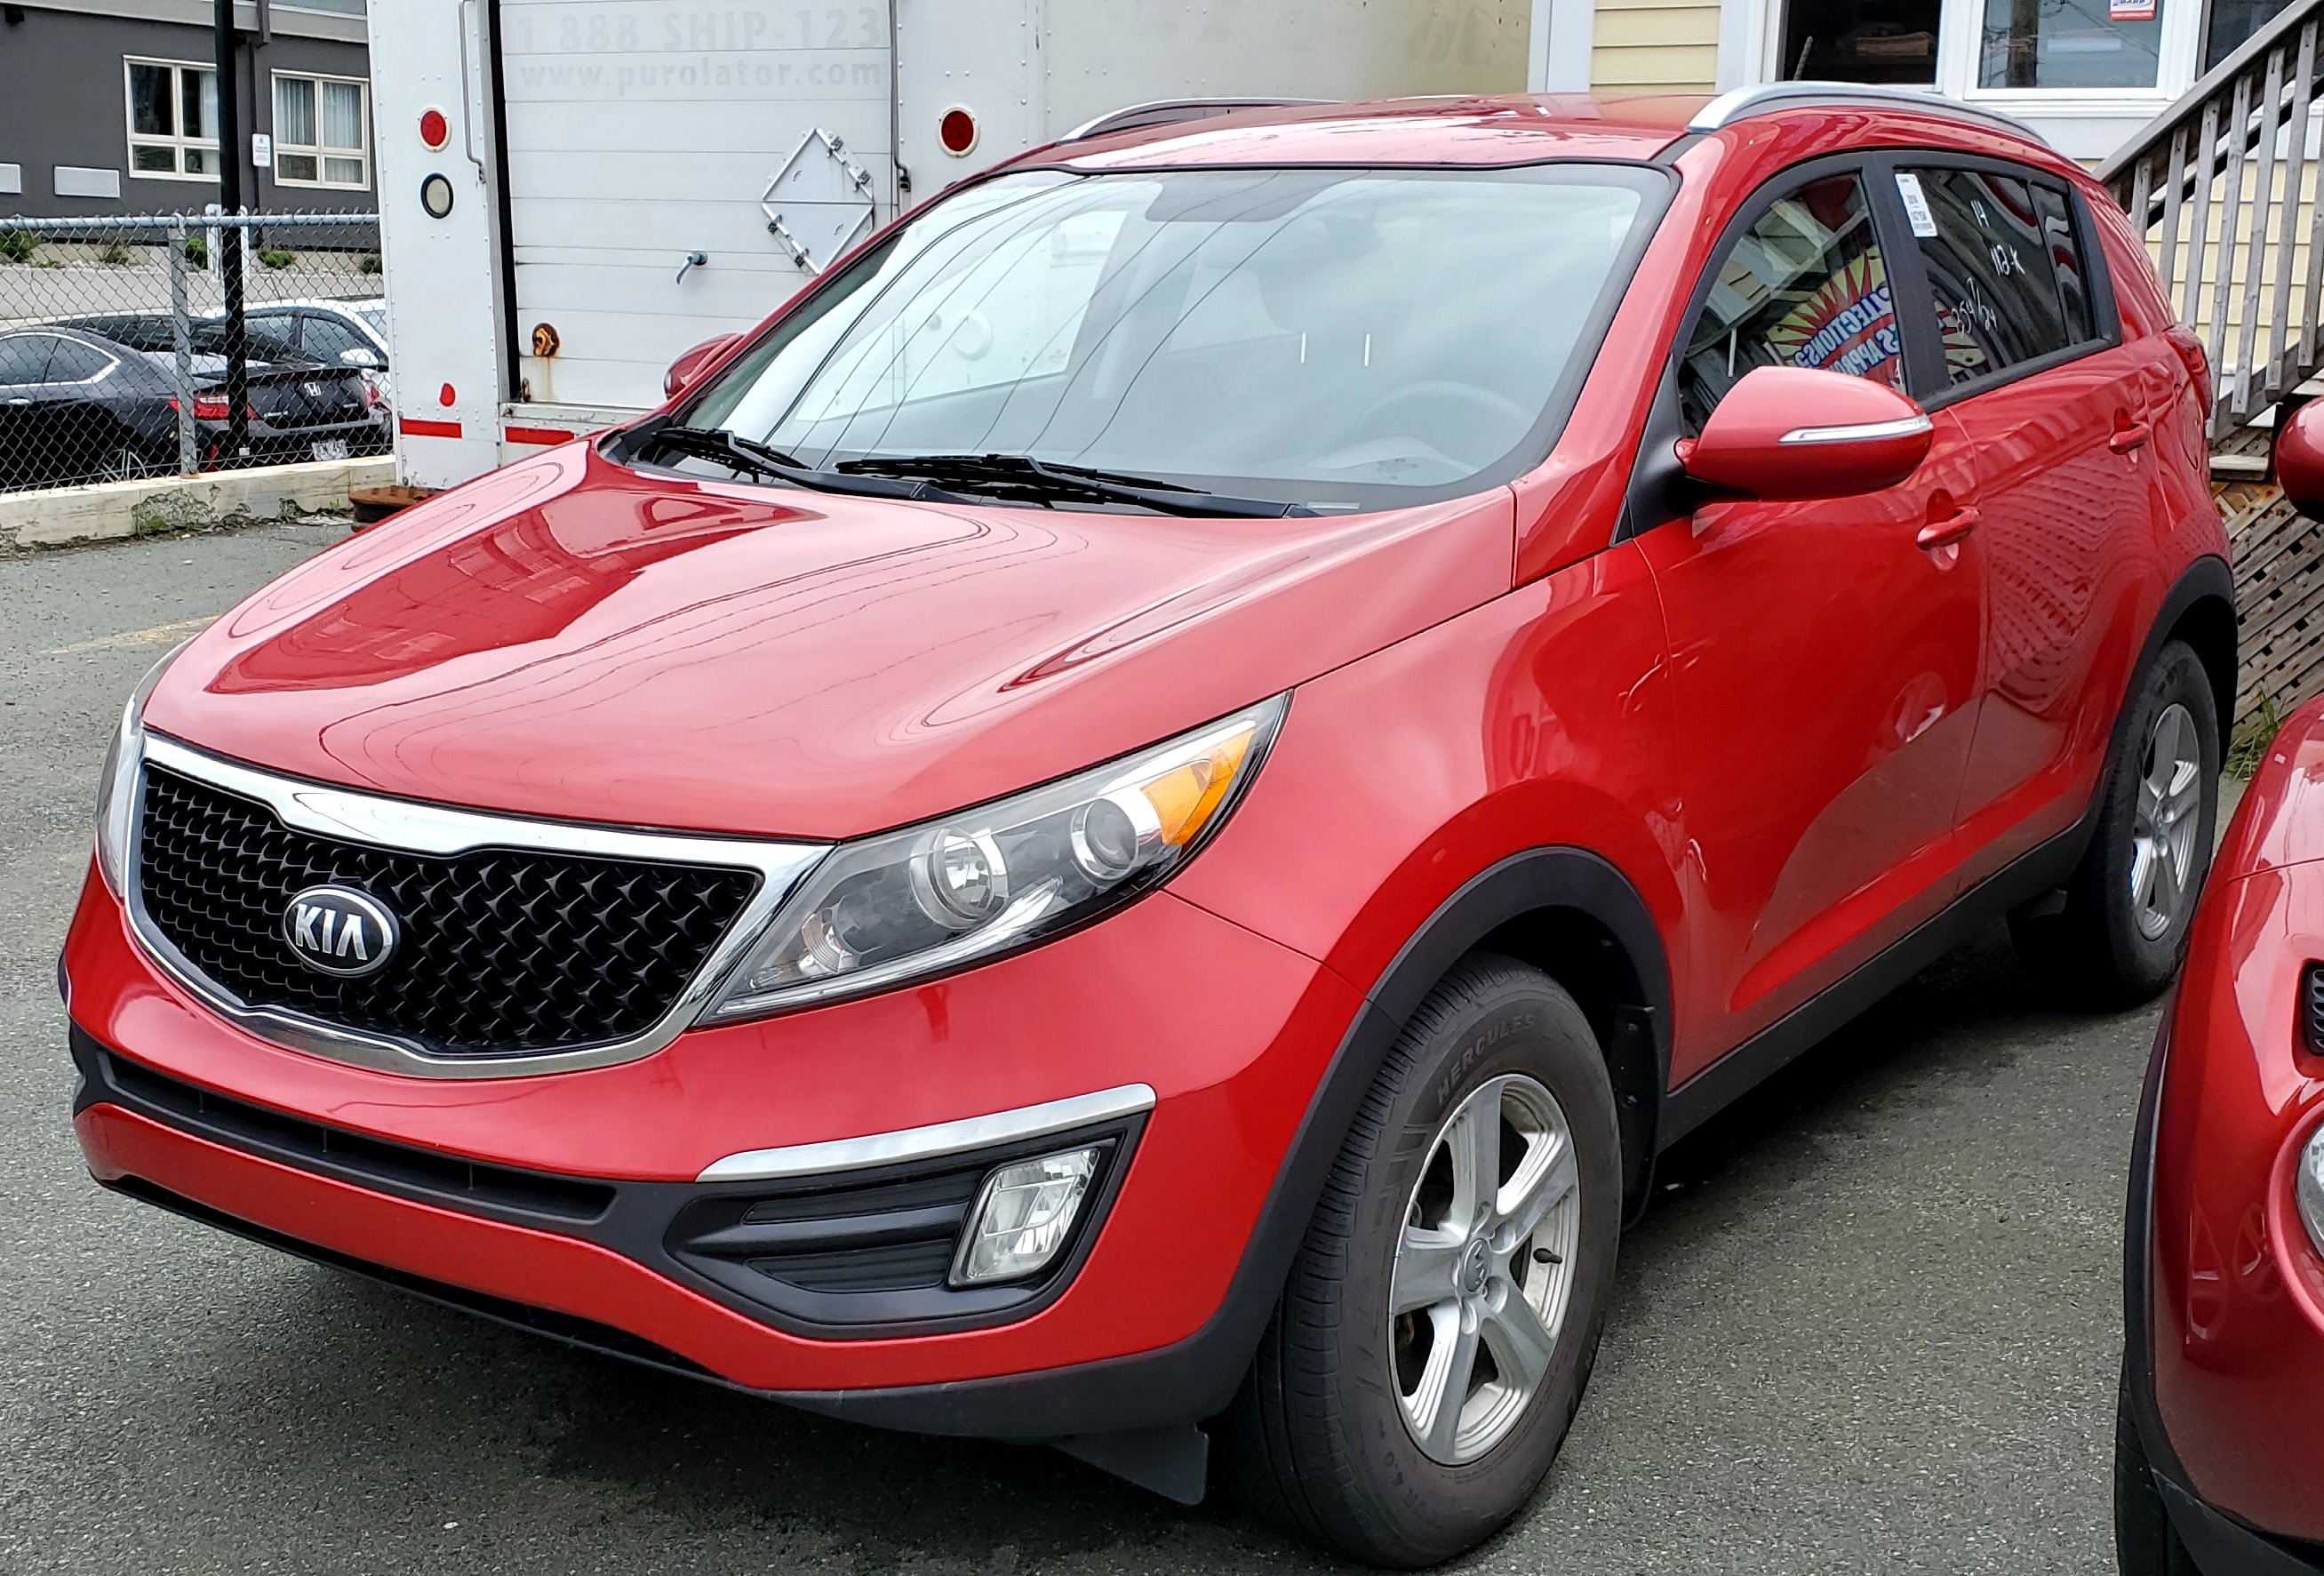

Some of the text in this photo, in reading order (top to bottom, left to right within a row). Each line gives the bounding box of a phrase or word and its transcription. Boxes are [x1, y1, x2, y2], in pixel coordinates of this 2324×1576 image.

[516, 7, 882, 52] 1 888 SHIP-123
[520, 56, 882, 96] www.purolator.com
[295, 903, 368, 961] KIA
[1436, 1012, 1535, 1106] HERCULES
